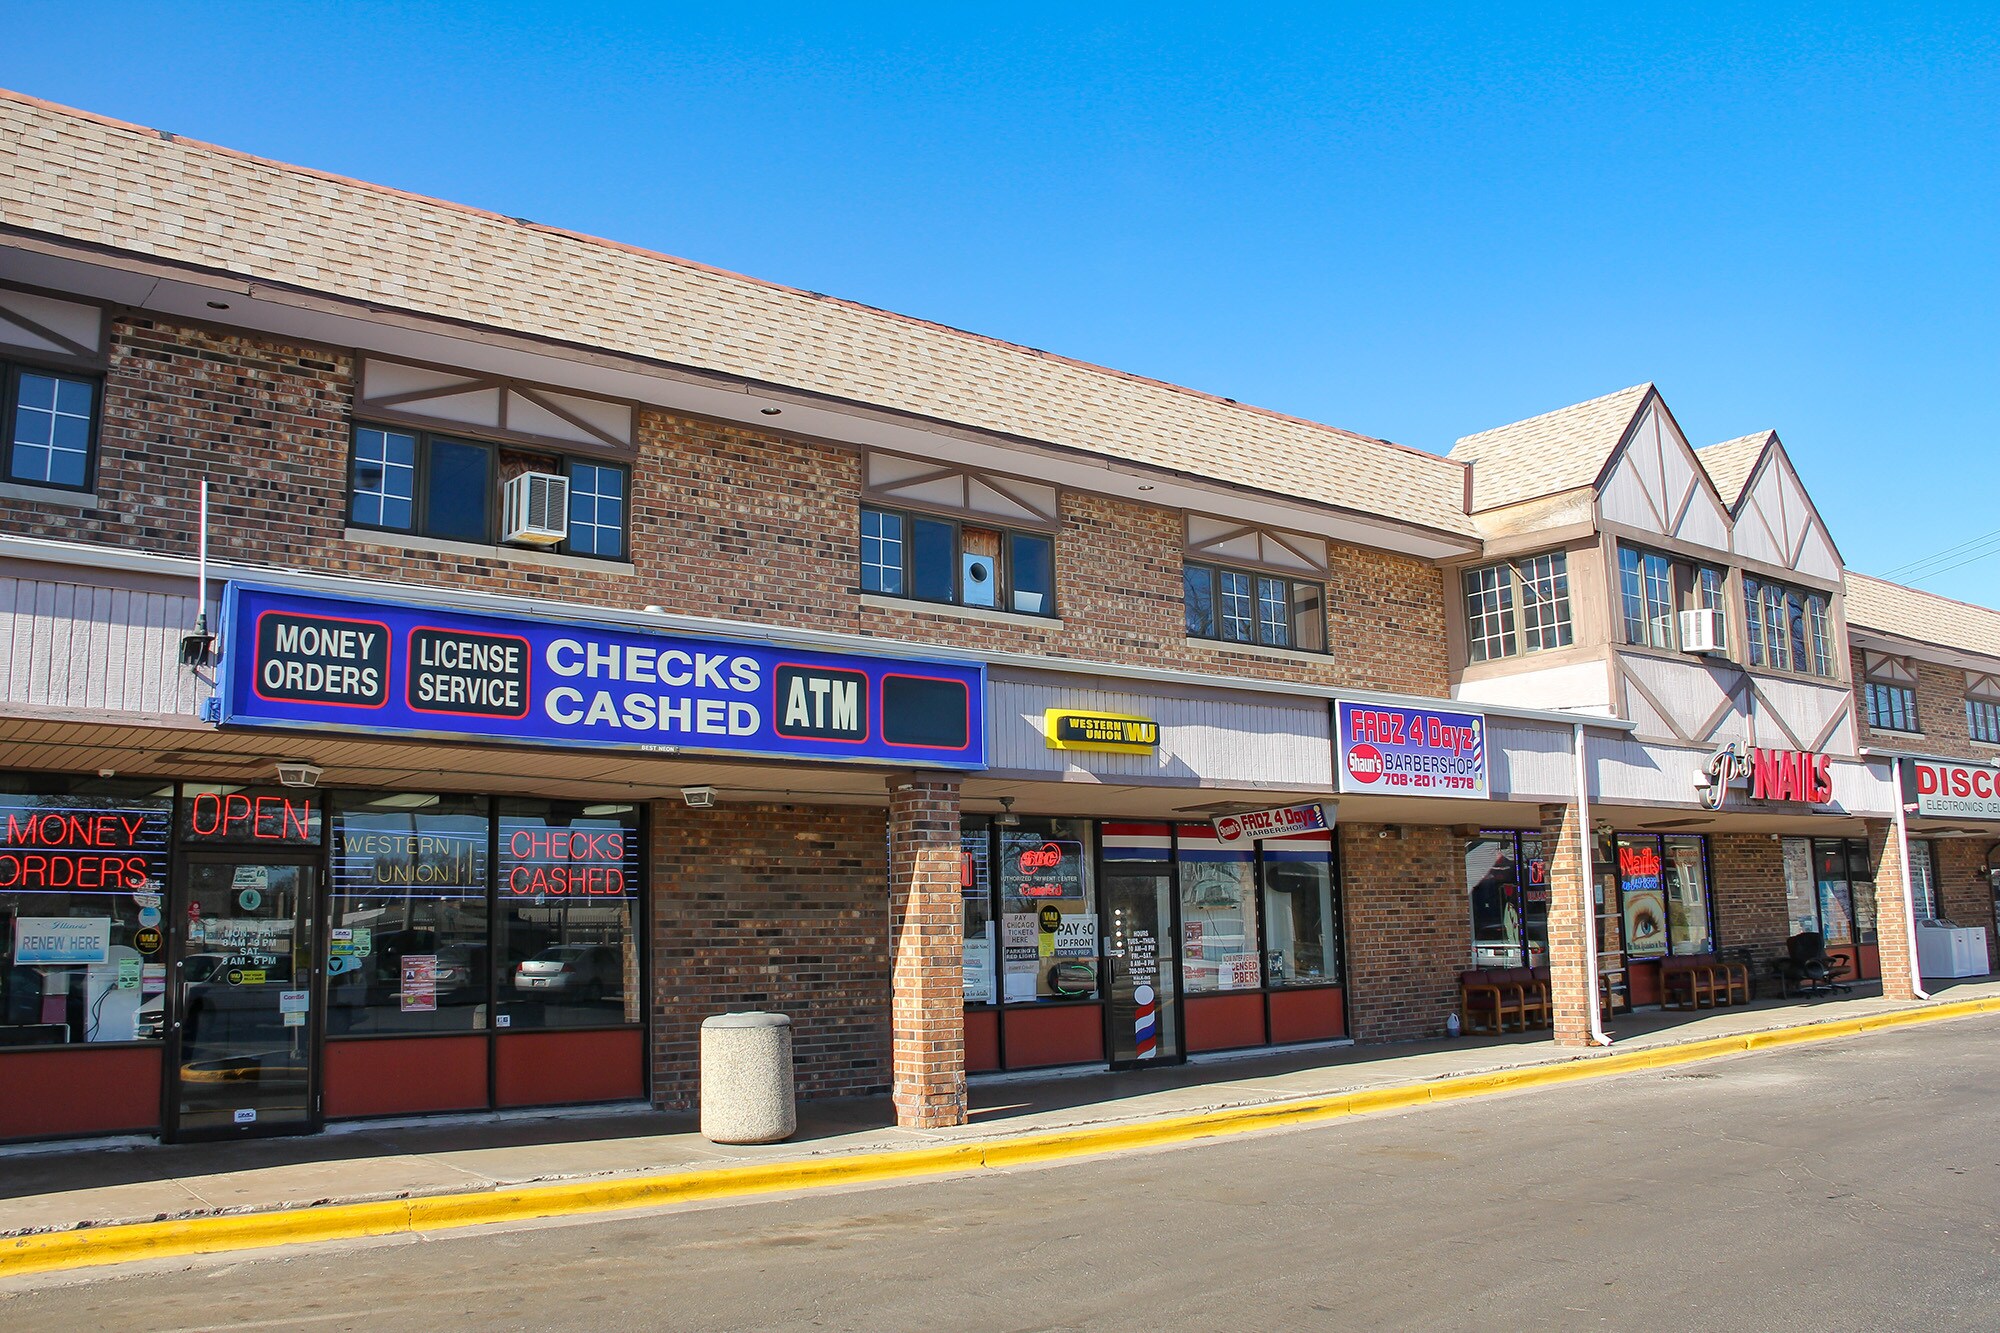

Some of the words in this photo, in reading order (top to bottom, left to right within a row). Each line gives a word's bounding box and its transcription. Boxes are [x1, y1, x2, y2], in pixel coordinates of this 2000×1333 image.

[275, 623, 375, 660] MONEY
[420, 638, 519, 674] LICENSE
[545, 638, 761, 693] CHECKS
[263, 659, 379, 698] ORDERS
[418, 672, 519, 708] SERVICE
[545, 686, 760, 737] CASHED
[785, 676, 858, 731] ATM
[1069, 718, 1121, 731] WESTERN
[1086, 730, 1121, 741] UNION
[1127, 722, 1156, 743] WU
[1350, 709, 1405, 745] FADZ
[1409, 715, 1424, 746] 4
[1426, 716, 1474, 757] Dayz
[1349, 752, 1382, 773] Shaun's
[1385, 753, 1473, 775] BARBERSHOP
[1752, 747, 1833, 804] NAILS
[193, 793, 310, 840] OPEN
[1926, 799, 1984, 813] ELECTRONICS
[8, 814, 144, 846] MONEY
[1240, 812, 1273, 830] FADZ
[1274, 810, 1284, 826] 4
[1283, 808, 1317, 827] Dayz
[1246, 824, 1304, 837] BARBERSHOP
[344, 835, 450, 856] WESTERN
[510, 830, 625, 861] CHECKS
[0, 855, 147, 888] ORDERS
[1619, 847, 1661, 877] Nails
[378, 864, 449, 883] UNION
[510, 866, 624, 895] CASHED
[52, 920, 88, 931] Illinois
[1057, 922, 1080, 936] PAY
[23, 936, 65, 950] RENEW
[70, 936, 101, 950] HERE
[230, 939, 246, 947] AM
[262, 939, 277, 947] PM
[1057, 939, 1068, 947] UP
[1069, 938, 1094, 947] FRONT
[230, 957, 246, 965] AM
[253, 957, 260, 965] 6
[262, 957, 277, 965] PM
[1230, 961, 1257, 971] CENSED
[1232, 971, 1259, 984] RBERS
